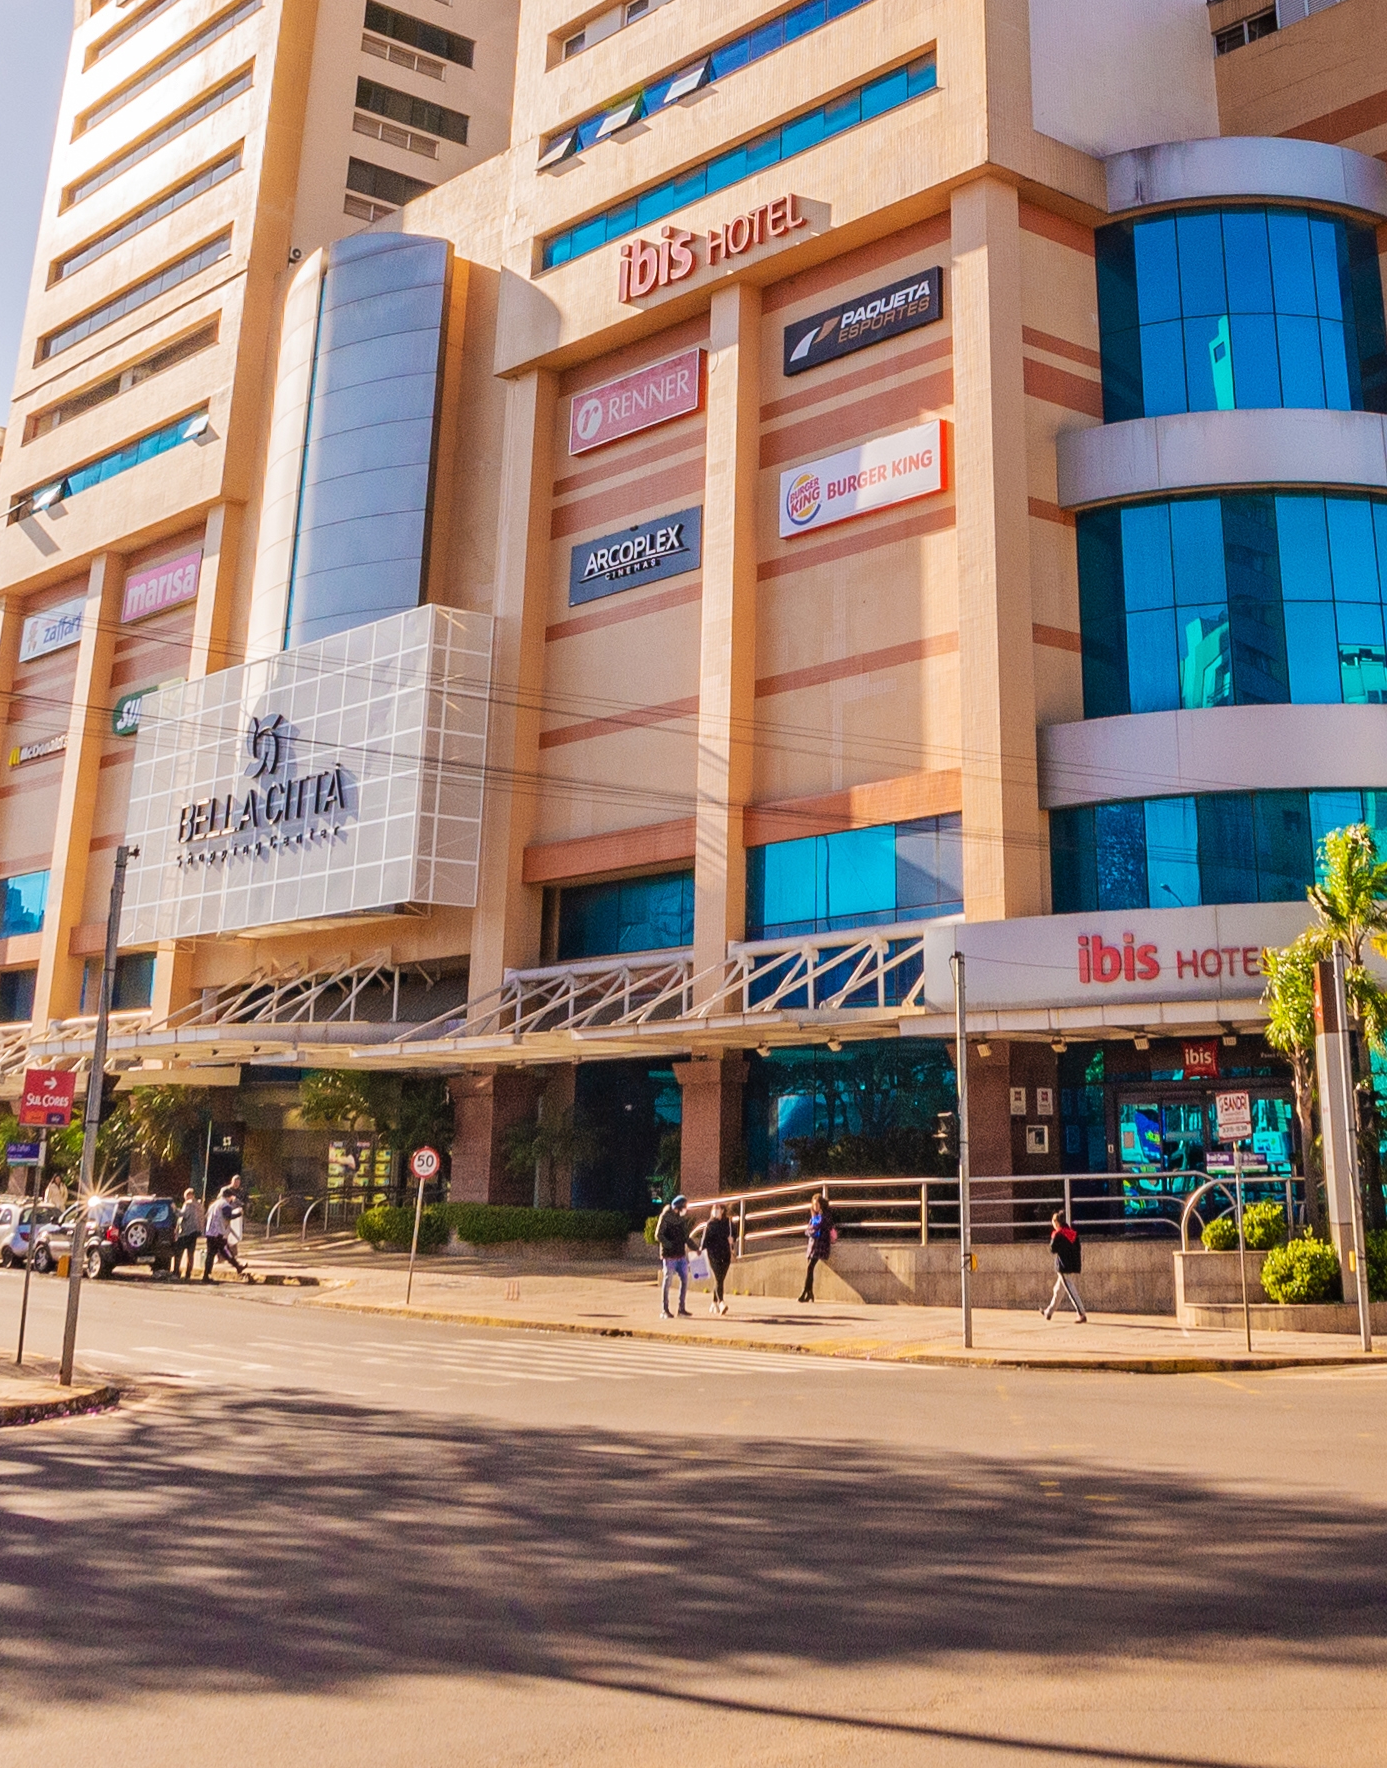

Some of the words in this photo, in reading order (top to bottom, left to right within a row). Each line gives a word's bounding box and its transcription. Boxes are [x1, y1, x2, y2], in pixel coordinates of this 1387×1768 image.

[618, 225, 697, 303] ibis
[707, 193, 808, 265] HOTEL
[838, 296, 930, 344] ESPORTES
[607, 369, 690, 424] RENNER
[790, 477, 820, 505] BURGER
[827, 464, 888, 500] BURGER
[891, 449, 933, 479] KING
[790, 487, 821, 518] KING
[584, 524, 680, 576] ARCOPLEX
[605, 559, 657, 581] CINEMAS
[124, 563, 196, 615] marisa
[42, 610, 82, 644] zaffari
[177, 789, 258, 845] BELLA
[177, 842, 262, 868] Shopping
[270, 825, 340, 849] Center
[1077, 932, 1161, 984] ibis
[1184, 1048, 1213, 1066] ibis
[417, 1154, 434, 1168] 50
